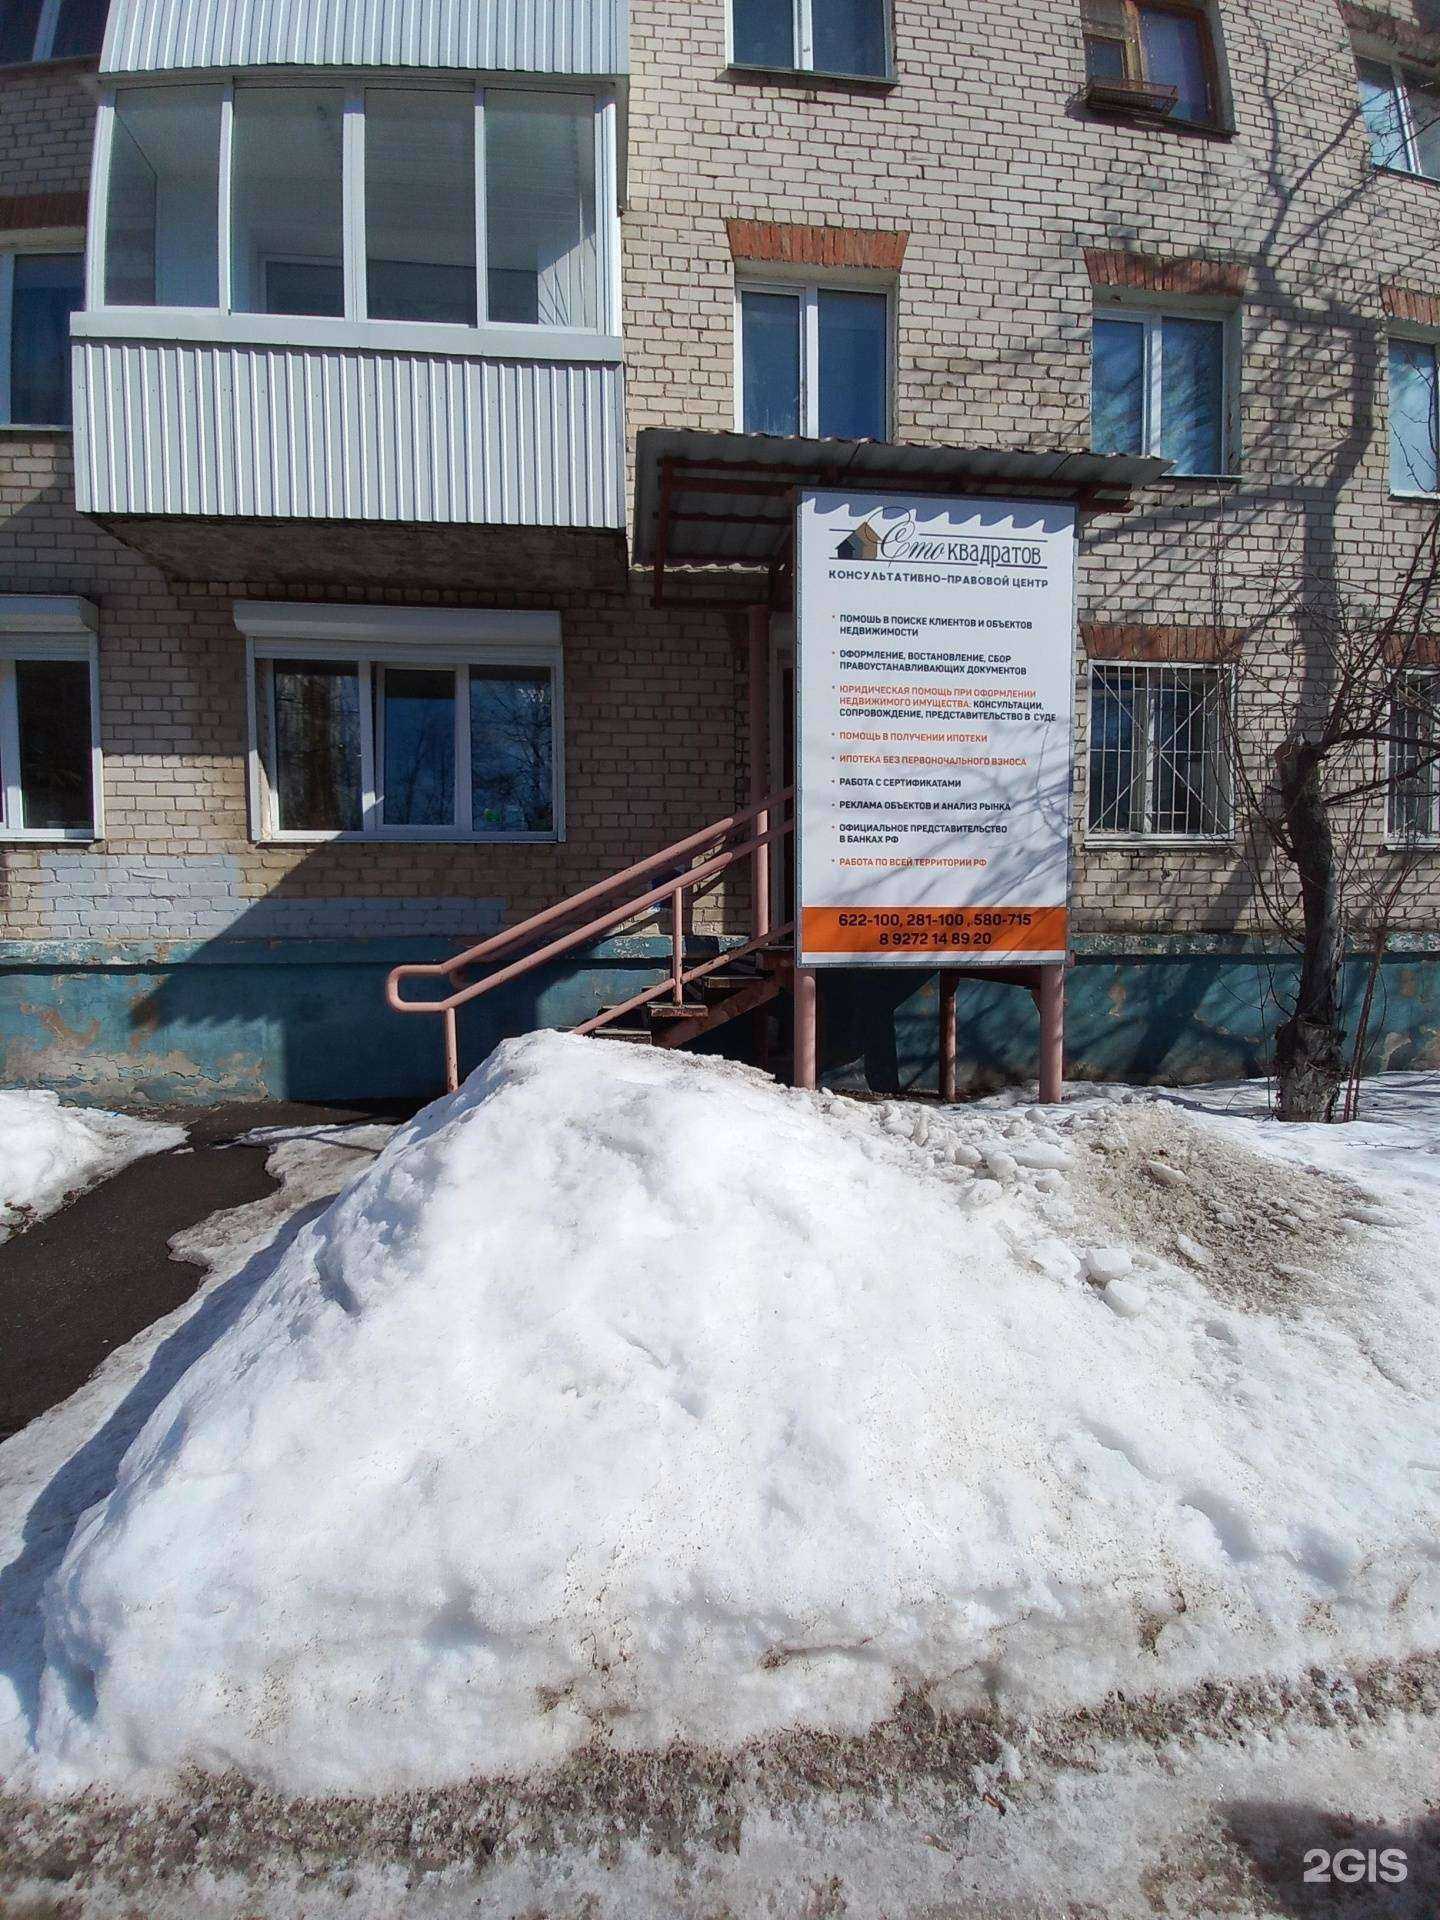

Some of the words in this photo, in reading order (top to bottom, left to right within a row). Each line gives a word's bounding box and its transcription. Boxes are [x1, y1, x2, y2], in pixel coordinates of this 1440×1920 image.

[828, 570, 1009, 587] КОНСУЛЬТАТИВНО-ПРАВОВОЙ
[1012, 577, 1048, 588] ЦЕНТР
[883, 616, 889, 624] В
[891, 616, 928, 626] ПОИСКЕ
[928, 617, 976, 627] КЛИЕНТОВ
[978, 618, 985, 627] И
[986, 619, 1033, 630] ОБЪЕКТОВ
[840, 626, 919, 637] НЕДВИЖИМОСТИ
[839, 650, 906, 661] ОФОРМЛЕНИЕ,
[908, 652, 986, 663] ВОСТАНОВЛЕНИЕ,
[987, 654, 1011, 663] СБОР
[840, 661, 965, 674] ПРАВОУСТАНАВЛИВАЮЩИХ
[966, 665, 1027, 676] ДОКУМЕНТОВ
[840, 685, 910, 695] ЮРИДИЧЕСКАЯ
[911, 687, 952, 697] ПОМОЩЬ
[953, 688, 972, 697] ПРИ
[973, 688, 1036, 699] ОФОРМЛЕНИИ
[840, 697, 911, 708] НЕДВИЖИМОГО
[973, 700, 1044, 711] КОНСУЛЬТАЦИИ,
[839, 708, 924, 719] СОПРОВОЖДЕНИЕ,
[925, 710, 1023, 721] ПРЕДСТАВИТЕЛЬСТВО
[1024, 712, 1030, 721] В
[1033, 713, 1057, 723] СУДЕ
[839, 731, 881, 742] ПОМОЩЬ
[882, 732, 888, 741] В
[890, 732, 944, 742] ПОЛУЧЕНИИ
[946, 733, 988, 742] ИПОТЕКИ
[839, 755, 882, 764] ИПОТЕКА
[883, 756, 900, 764] БЕЗ
[991, 757, 1027, 767] ВЗНОСА
[839, 778, 874, 787] РАБОТА
[876, 778, 881, 787] С
[883, 778, 962, 788] СЕРТИФИКАТАМИ
[839, 801, 883, 810] РЕКЛАМА
[884, 801, 932, 810] ОБЪЕКТОВ
[933, 802, 940, 810] И
[941, 802, 978, 811] АНАЛИЗ
[979, 803, 1011, 811] РЫНКА
[839, 824, 909, 833] ОФИЦИАЛЬНОЕ
[910, 824, 1007, 834] ПРЕДСТАВИТЕЛЬСТВО
[839, 835, 846, 843] В
[847, 835, 883, 844] БАНКАХ
[885, 835, 899, 844] РФ
[839, 858, 873, 867] РАБОТА
[875, 858, 888, 866] ПО
[889, 857, 912, 867] ВСЕЙ
[973, 858, 987, 867] РФ
[838, 913, 903, 928] 622-100,
[879, 933, 888, 945] 8
[892, 932, 928, 945] 9272
[931, 933, 947, 945] 14
[951, 933, 970, 945] 89
[973, 932, 992, 945] 20
